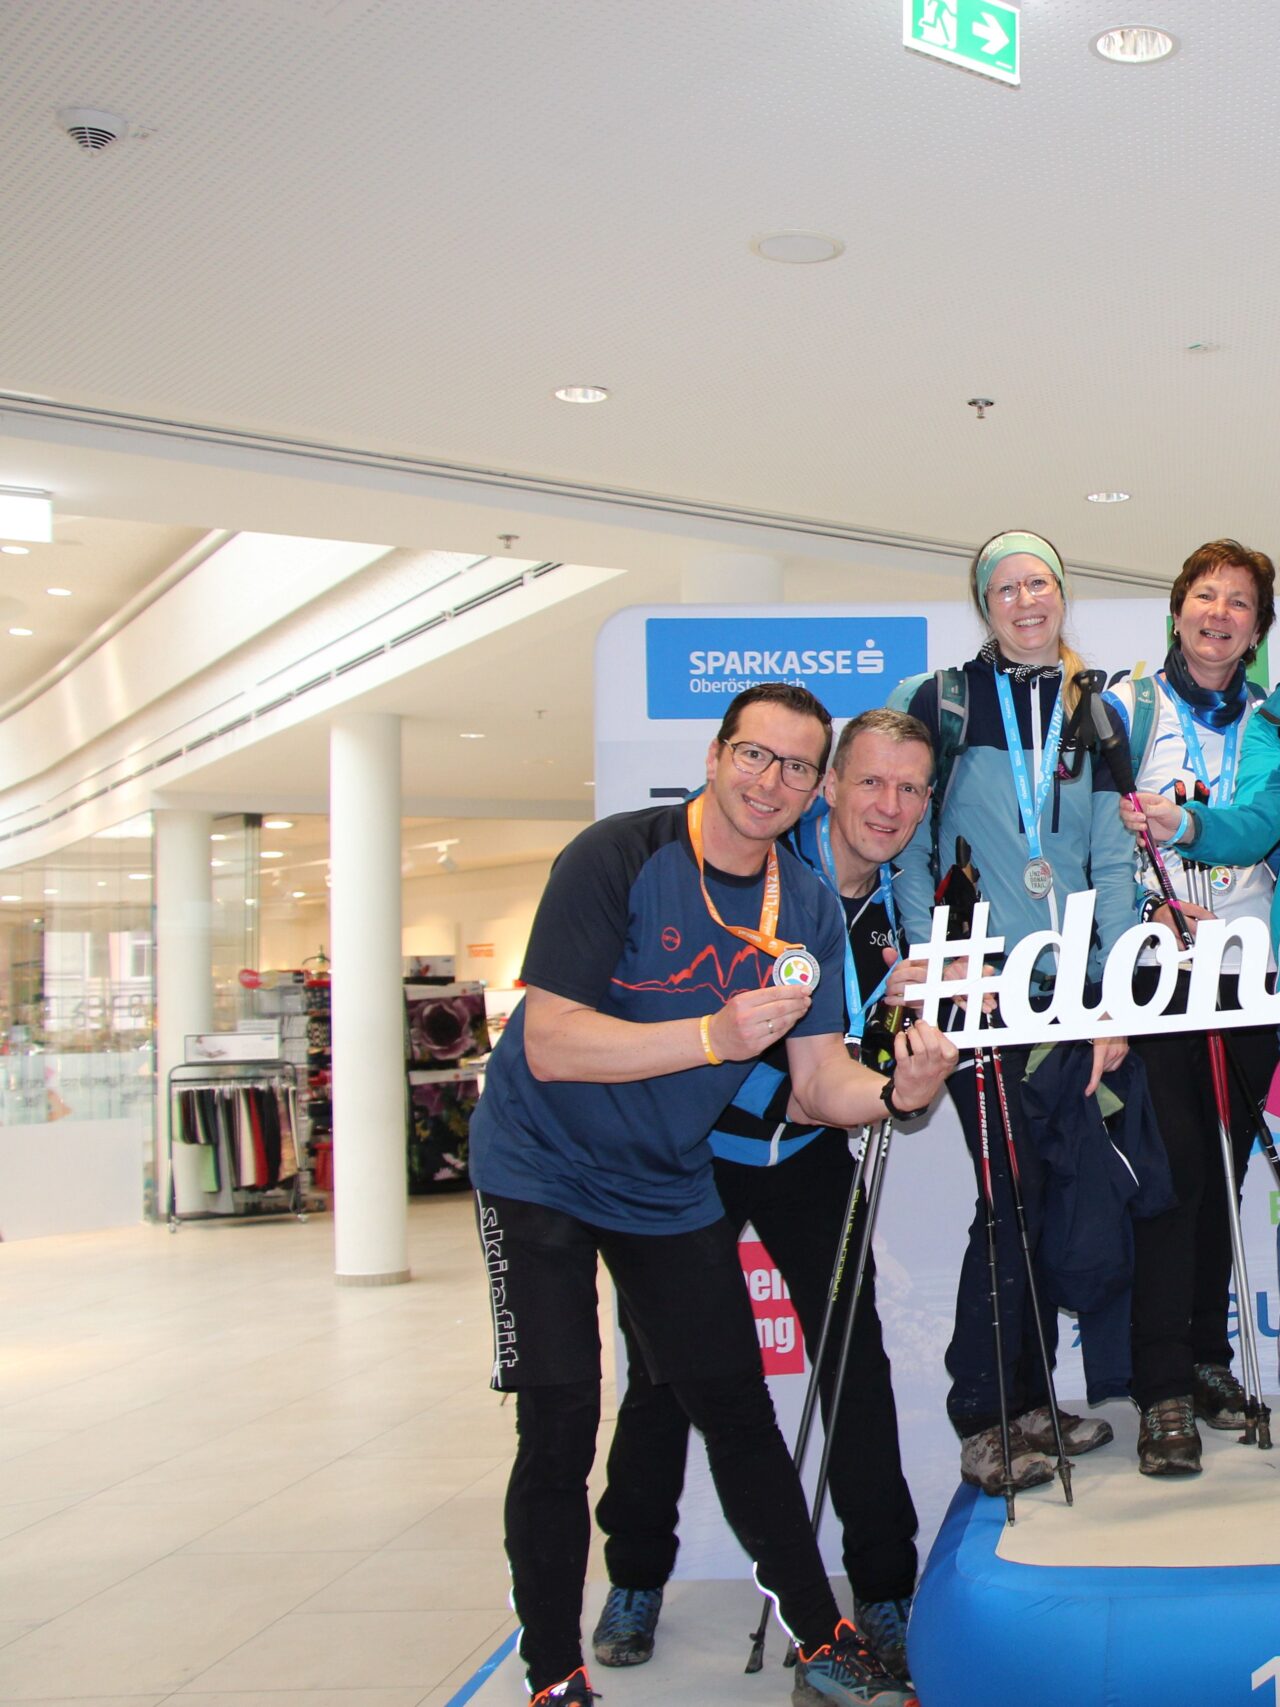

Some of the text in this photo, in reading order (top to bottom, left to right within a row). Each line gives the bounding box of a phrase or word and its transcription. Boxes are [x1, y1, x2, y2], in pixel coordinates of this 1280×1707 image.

[689, 650, 852, 675] SPARKASSE
[978, 1090, 990, 1159] SUPREME
[482, 1207, 519, 1369] skinfit
